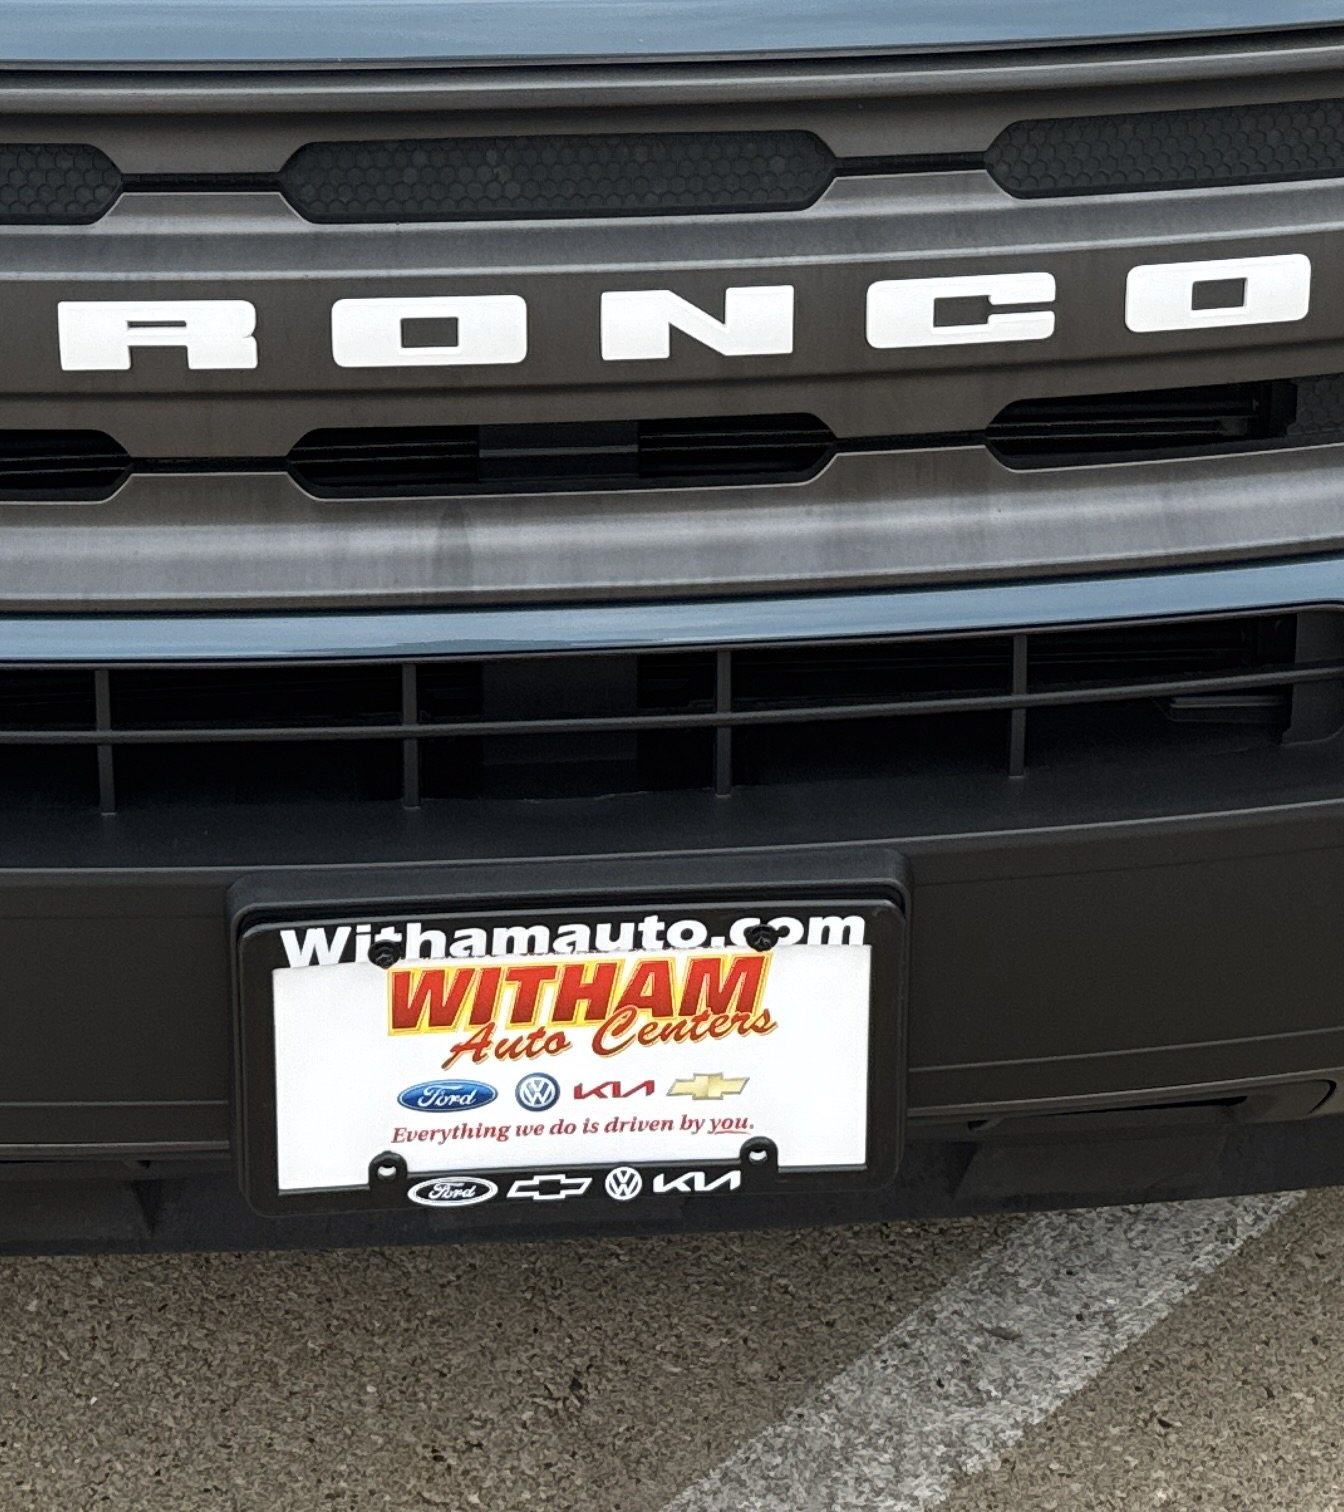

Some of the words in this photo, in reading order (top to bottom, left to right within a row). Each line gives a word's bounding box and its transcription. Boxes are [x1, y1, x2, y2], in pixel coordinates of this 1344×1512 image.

[280, 915, 866, 969] Withamauto.com
[389, 953, 771, 1033] WITHAM
[441, 1021, 571, 1070] Auto
[592, 1005, 778, 1057] Centers
[417, 1084, 477, 1107] Ford
[391, 1122, 511, 1145] Everything
[515, 1124, 544, 1136] we
[549, 1118, 577, 1135] do
[582, 1117, 599, 1134] is
[604, 1115, 674, 1133] driven
[678, 1114, 706, 1135] by
[706, 1116, 755, 1134] you.
[427, 1181, 477, 1200] Ford
